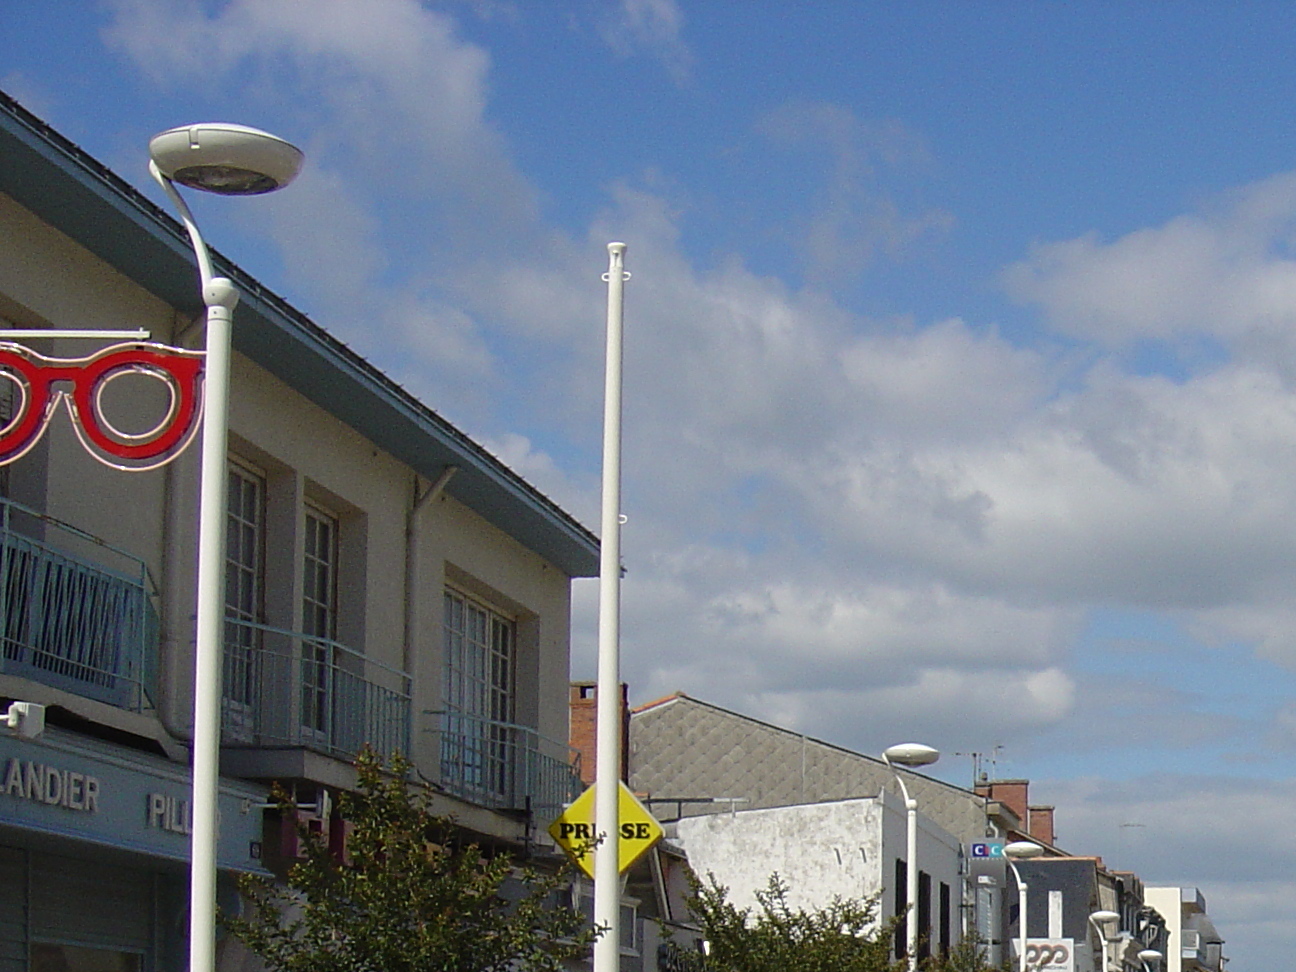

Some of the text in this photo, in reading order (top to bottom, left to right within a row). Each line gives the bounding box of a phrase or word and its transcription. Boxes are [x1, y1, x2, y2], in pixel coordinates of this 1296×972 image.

[0, 757, 100, 813] ANDIER
[559, 822, 650, 840] PRSE
[973, 844, 1000, 857] CIC
